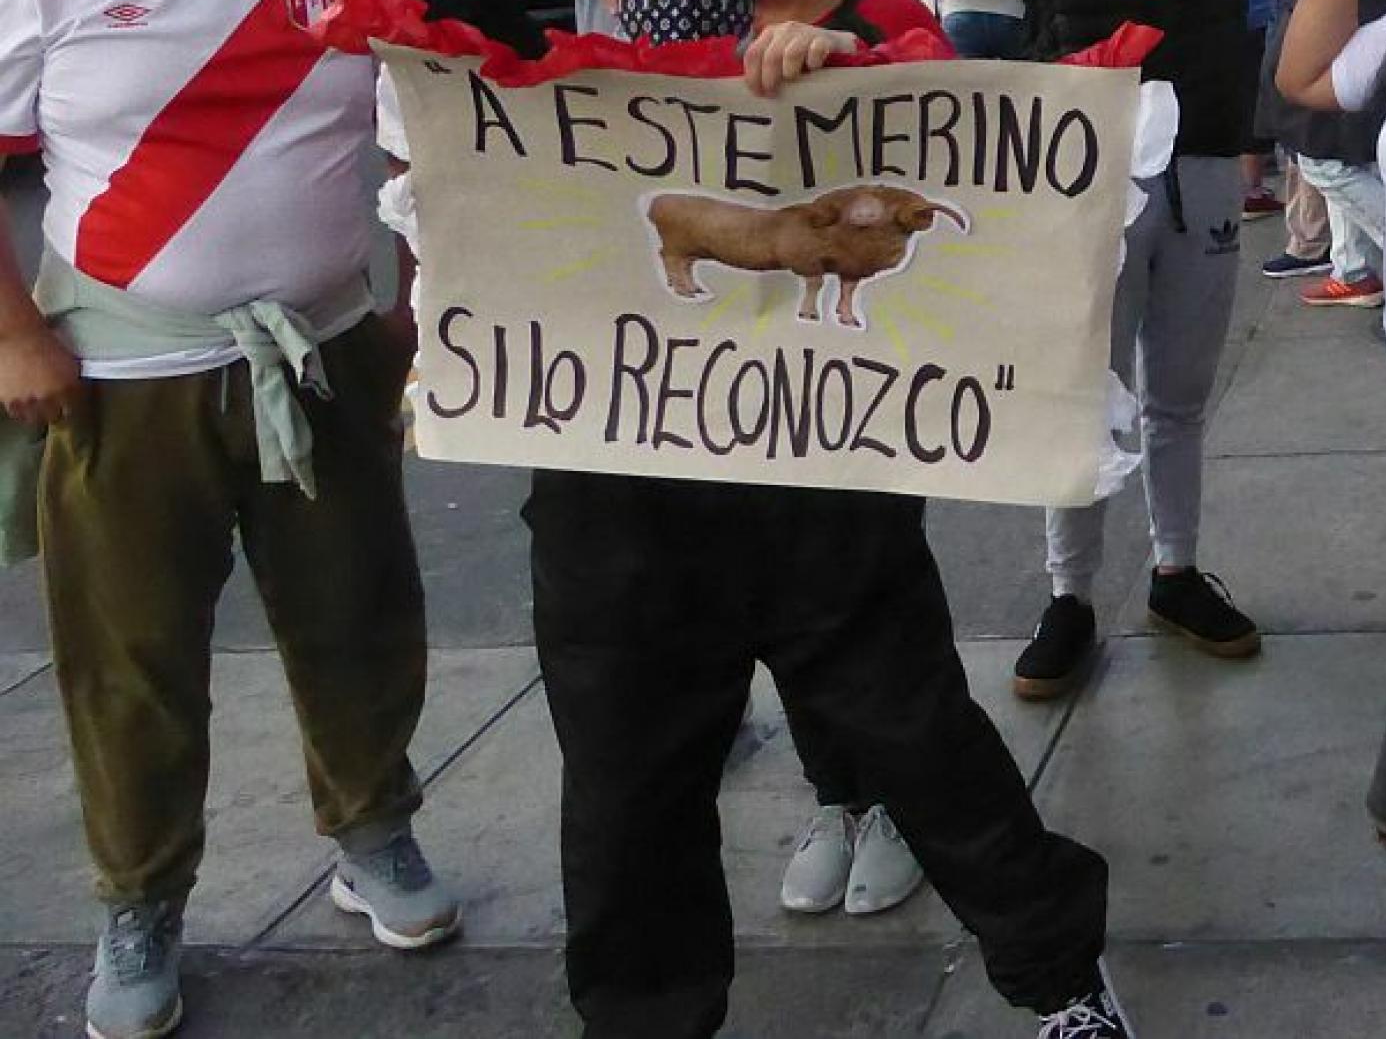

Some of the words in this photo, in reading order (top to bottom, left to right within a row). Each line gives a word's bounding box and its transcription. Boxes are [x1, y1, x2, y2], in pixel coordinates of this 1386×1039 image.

[554, 83, 780, 196] ESTE
[796, 90, 1100, 197] MERINO
[426, 306, 508, 419] SI
